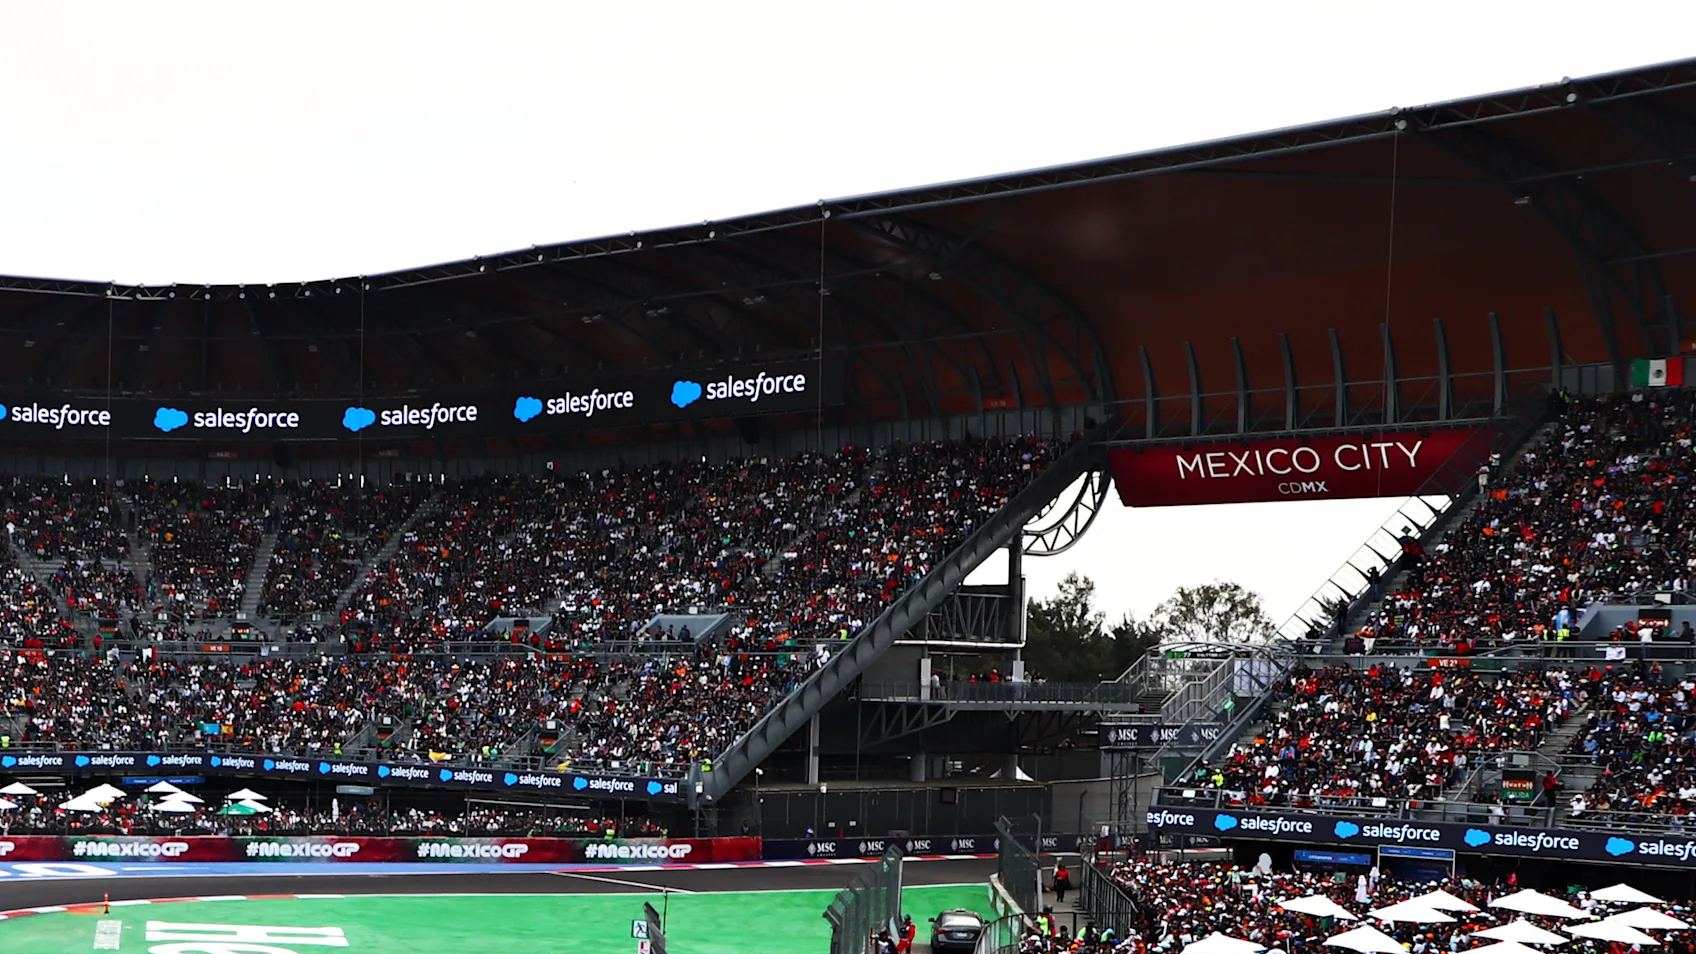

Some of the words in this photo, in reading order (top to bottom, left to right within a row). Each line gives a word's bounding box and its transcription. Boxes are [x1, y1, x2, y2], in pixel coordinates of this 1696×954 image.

[706, 371, 806, 401] salesforce
[547, 389, 633, 416] salesforce
[11, 402, 111, 429] salesforce
[194, 408, 299, 433] salesforce
[381, 403, 477, 428] salesforce
[1176, 447, 1320, 479] MEXICO
[1334, 441, 1422, 471] CITY
[1278, 481, 1329, 494] CDMX
[1439, 659, 1449, 668] VE
[1117, 728, 1138, 741] MSC
[1160, 728, 1180, 741] MSC
[1200, 728, 1220, 741] MSC
[18, 755, 63, 768] salesforce
[91, 754, 135, 767] salesforce
[162, 754, 203, 767] salesforce
[221, 755, 255, 770] salesforce
[275, 759, 310, 773] salesforce
[331, 762, 368, 777] salesforce
[390, 766, 430, 780] salesforce
[453, 769, 493, 785] salesforce
[518, 774, 562, 788] salesforce
[589, 777, 635, 793] salesforce
[1240, 816, 1313, 835] salesforce
[1362, 822, 1441, 843] salesforce
[816, 842, 837, 852] MSC
[867, 841, 885, 852] MSC
[914, 839, 931, 851] MSC
[958, 838, 975, 849] MSC
[1042, 837, 1058, 848] MSC
[1494, 830, 1580, 852] salesforce
[72, 841, 189, 857] #MexicoGP
[245, 841, 360, 858] #MexicoGP
[417, 842, 529, 858] #MexicoGP
[585, 842, 692, 859] #MexicoGP
